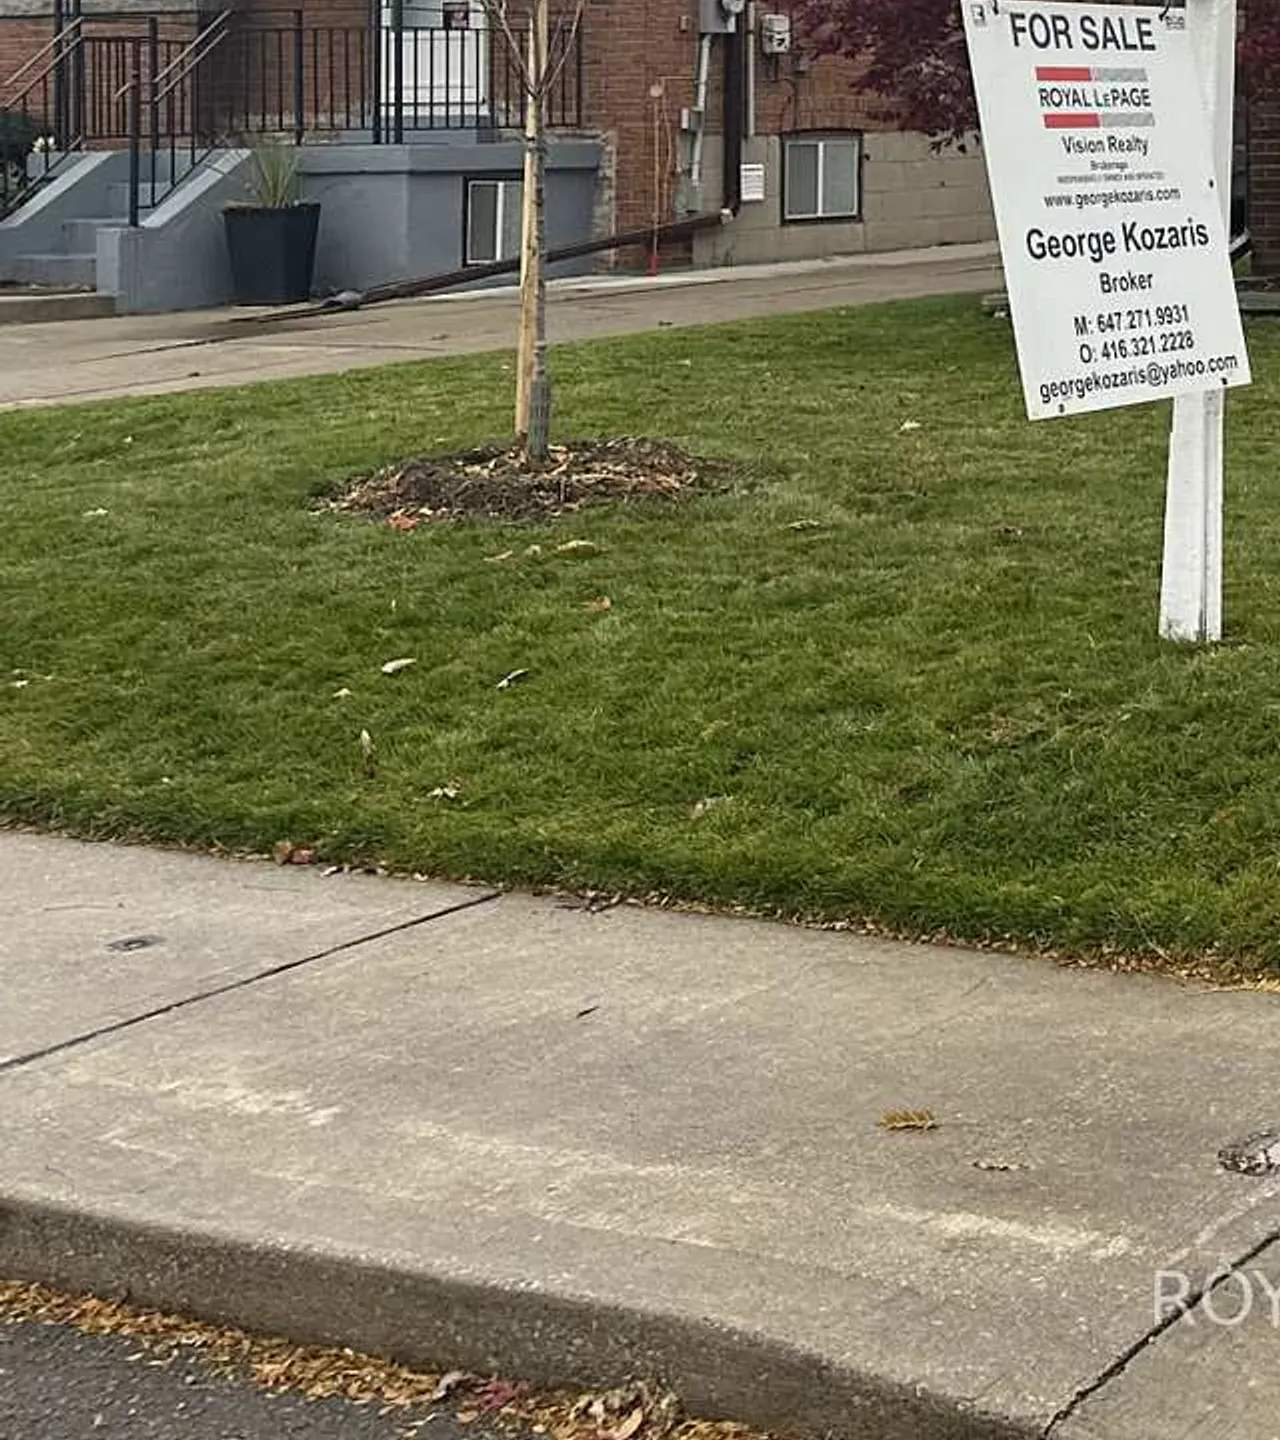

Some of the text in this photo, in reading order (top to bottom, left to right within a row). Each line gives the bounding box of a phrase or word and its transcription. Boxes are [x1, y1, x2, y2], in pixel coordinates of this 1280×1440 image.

[1009, 13, 1073, 49] FOR
[1080, 16, 1156, 51] SALE
[1039, 88, 1093, 107] ROYAL
[1062, 135, 1149, 156] Vision Realty
[1044, 188, 1181, 209] www.georgekozaris.com
[1026, 217, 1210, 263] George Kozaris
[1100, 271, 1153, 293] Broker
[1073, 304, 1190, 336] M: 647.271.9931
[1079, 342, 1098, 364] O:
[1040, 354, 1239, 404] georgekozaris@yahoo.com
